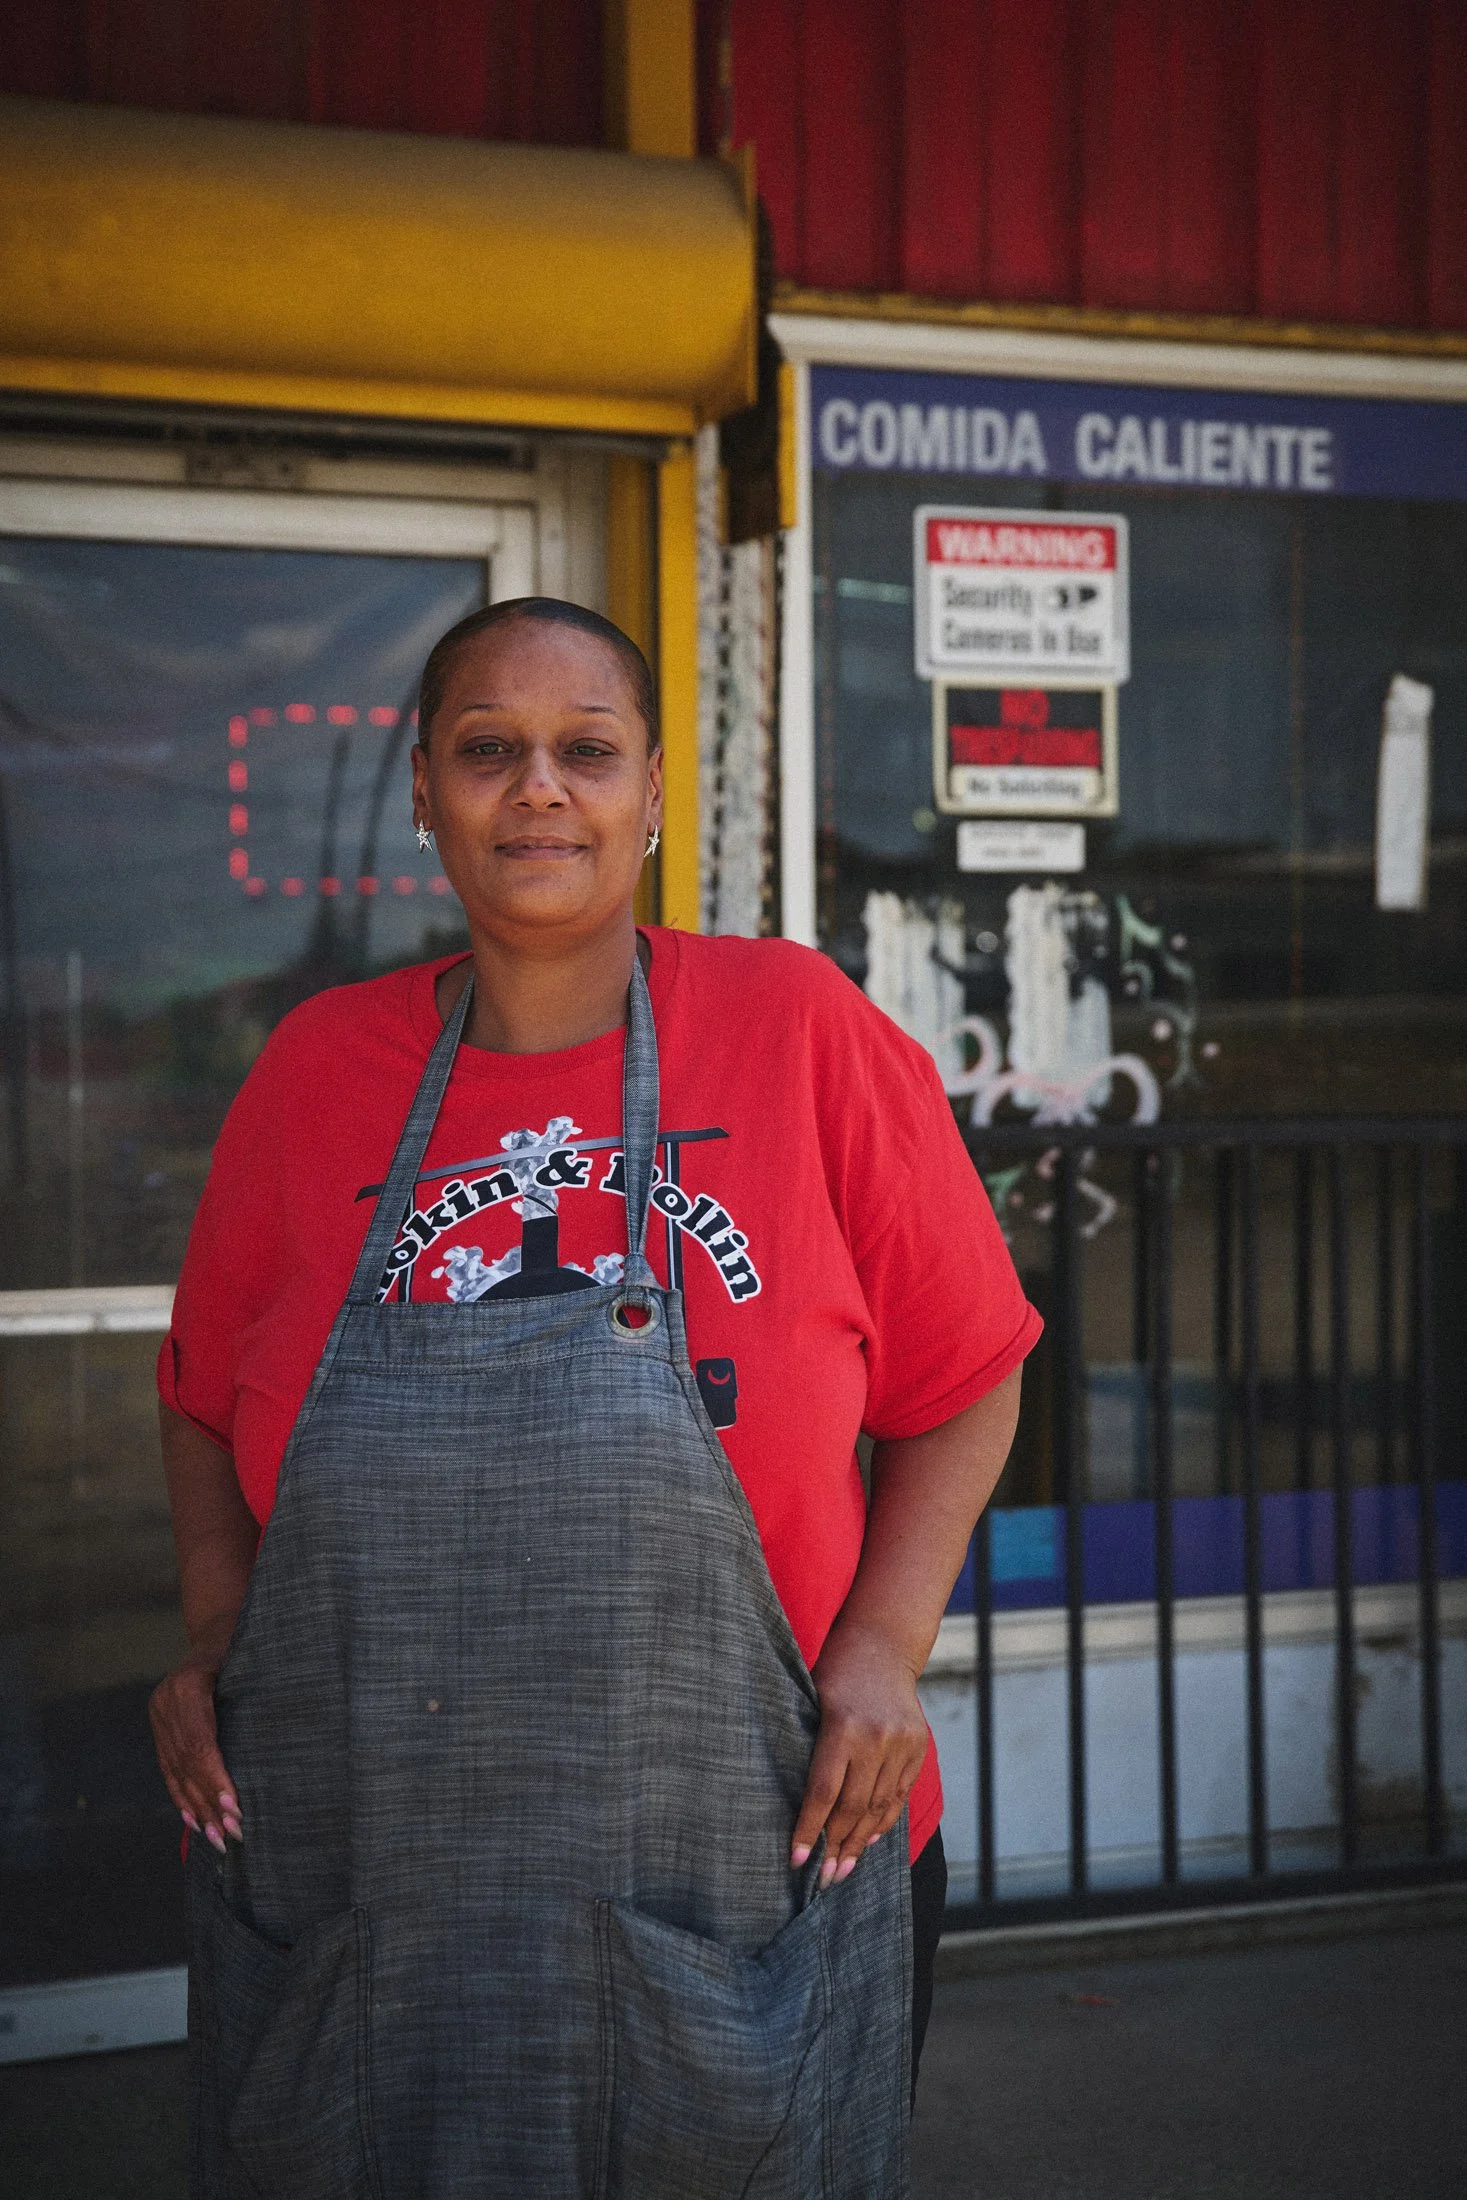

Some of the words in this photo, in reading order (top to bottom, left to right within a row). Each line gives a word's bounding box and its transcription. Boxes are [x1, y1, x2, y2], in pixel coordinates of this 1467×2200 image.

[819, 399, 1047, 475] COMIDA
[1075, 413, 1334, 490] CALIENTE
[938, 526, 1106, 565] WARNING
[944, 576, 1031, 618] Security
[374, 1169, 523, 1303] okin
[532, 1147, 594, 1190] &
